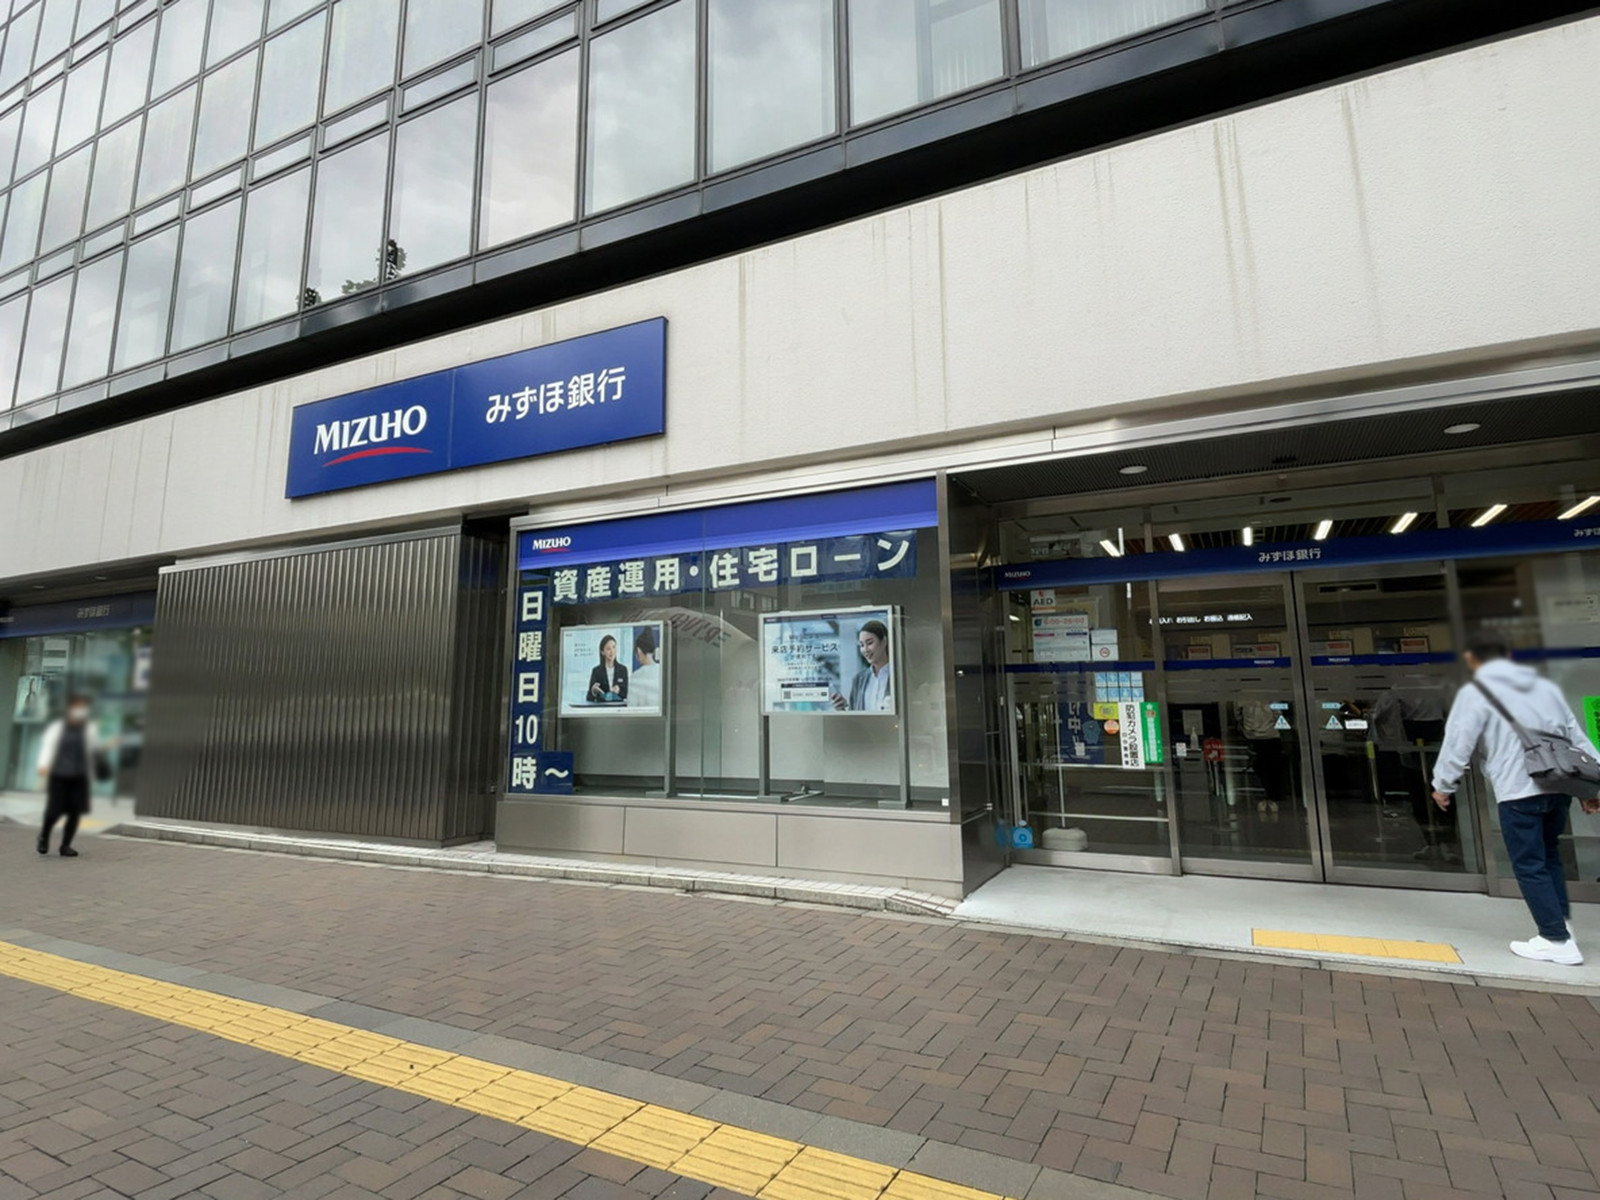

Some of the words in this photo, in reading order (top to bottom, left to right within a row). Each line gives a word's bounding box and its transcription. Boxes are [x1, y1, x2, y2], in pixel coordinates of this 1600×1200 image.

[485, 366, 626, 425] みずほ銀行
[312, 404, 428, 455] MIZUHO
[532, 536, 572, 551] MIZUHO
[1258, 548, 1322, 563] みずほ銀行
[552, 537, 910, 602] 資産運用・住宅ローン
[1033, 598, 1054, 606] AED
